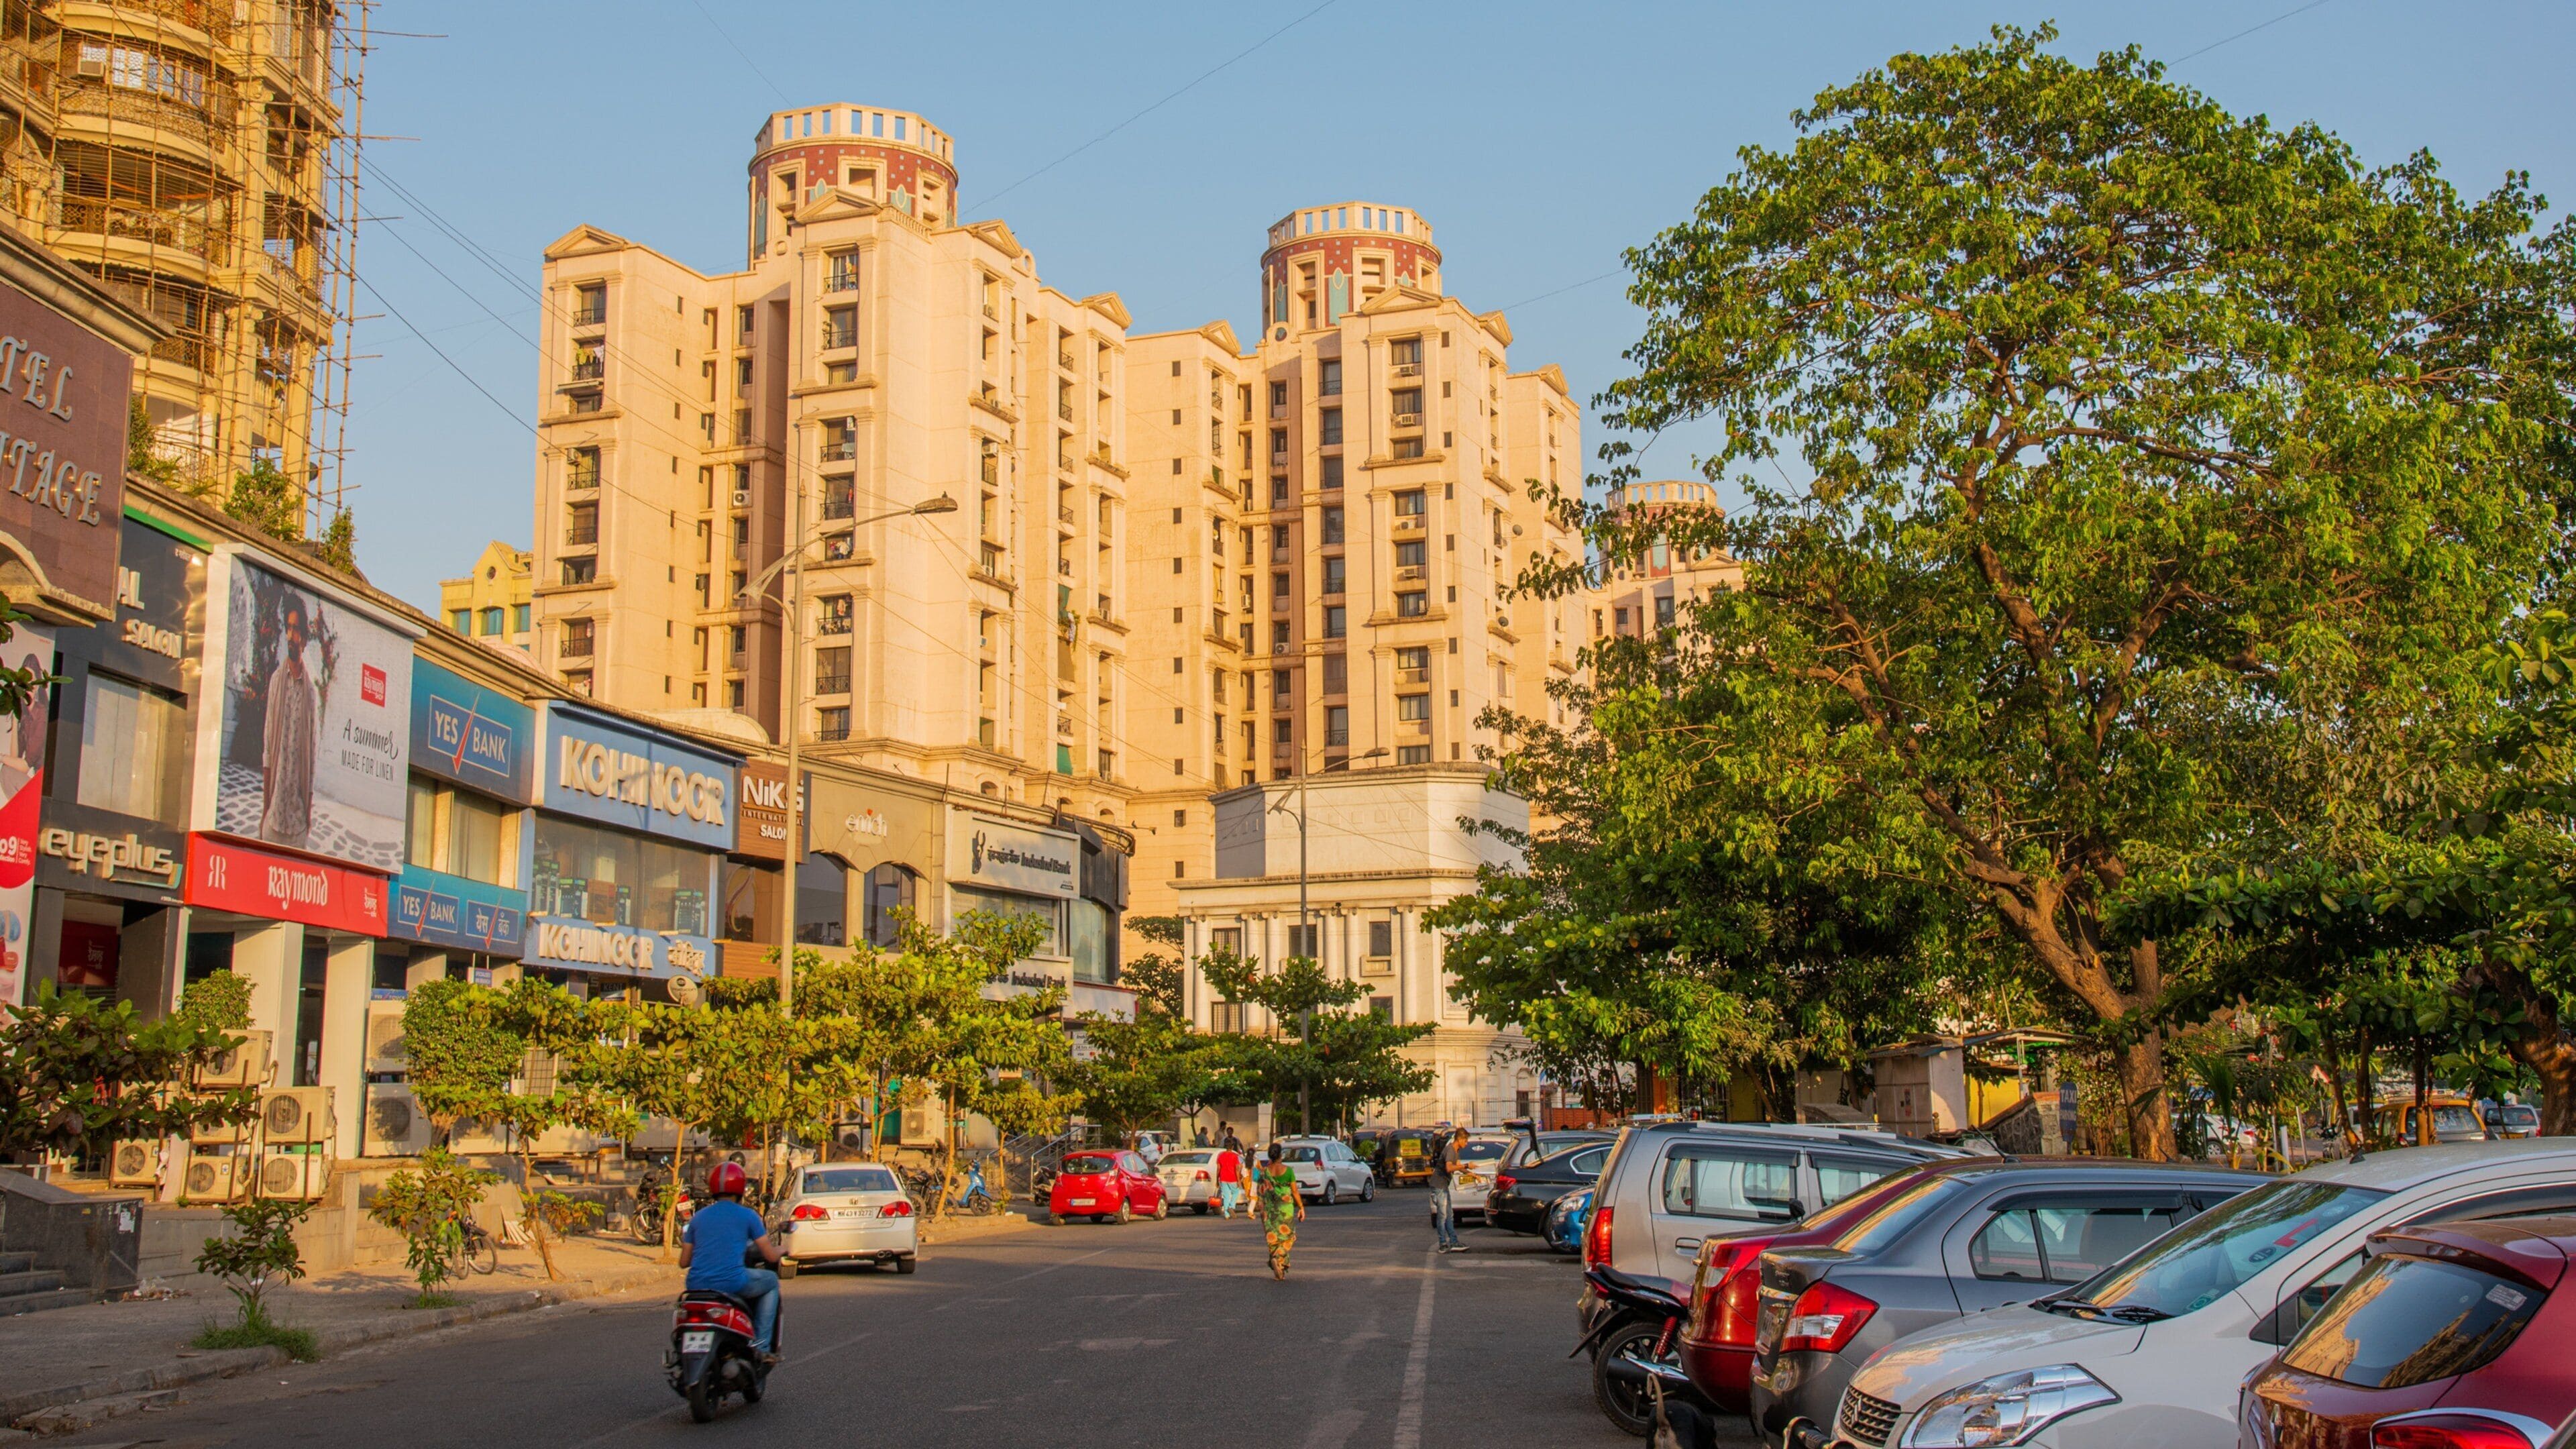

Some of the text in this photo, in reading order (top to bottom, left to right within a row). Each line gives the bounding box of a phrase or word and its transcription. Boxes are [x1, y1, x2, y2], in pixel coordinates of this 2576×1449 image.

[0, 335, 73, 421] TEL
[0, 431, 102, 526] TAGE
[122, 619, 182, 659] SALON
[343, 718, 398, 760] A summer
[435, 710, 506, 763] YES BANK
[341, 749, 394, 782] MADE FOR LINEN
[559, 735, 725, 826] KOHINOOR
[741, 809, 805, 826] INTERNATIAL
[40, 828, 173, 878] eyeplus
[1021, 852, 1071, 875] IndusInd Bank
[268, 865, 329, 911] Raymond
[403, 894, 455, 924] YES BANK
[539, 923, 654, 971] KOHINOOR
[1011, 971, 1046, 988] IndusInd
[2060, 1089, 2077, 1104] TAXI
